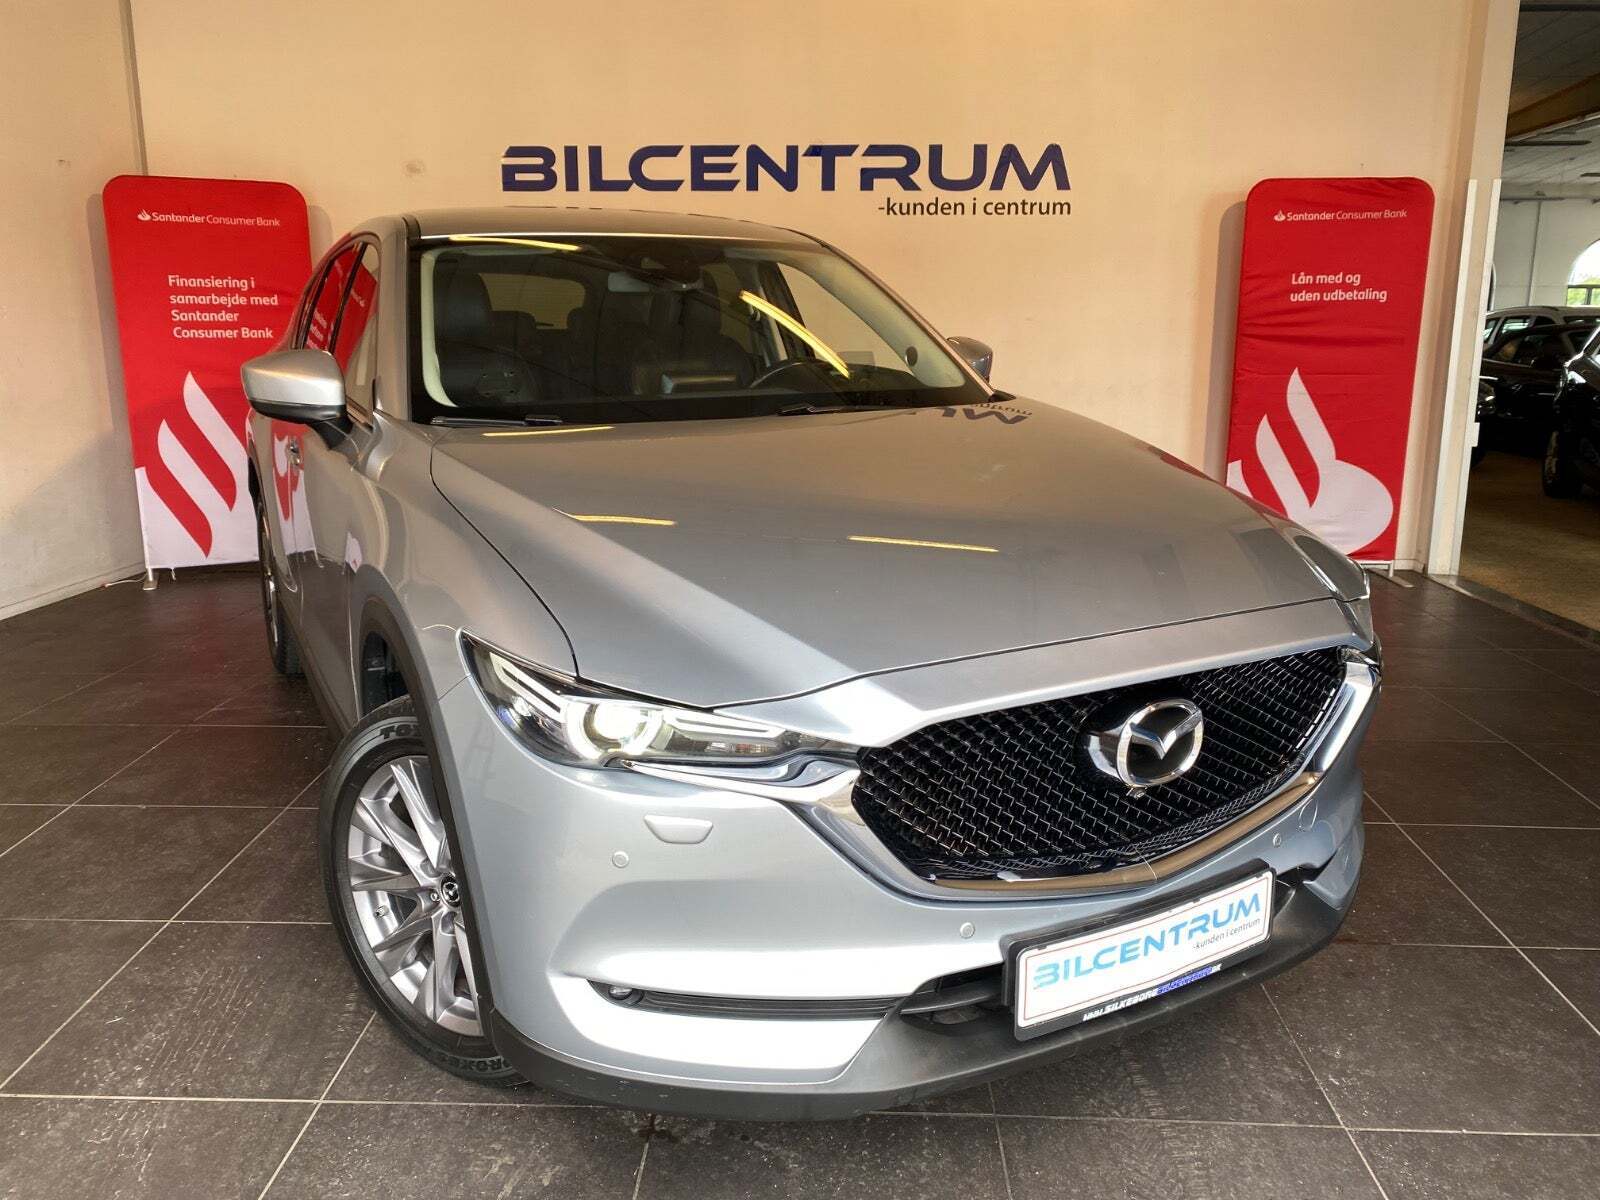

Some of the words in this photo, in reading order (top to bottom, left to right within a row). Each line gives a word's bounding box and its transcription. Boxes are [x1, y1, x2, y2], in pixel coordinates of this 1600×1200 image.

[502, 143, 1071, 192] BILCENTRUM
[878, 197, 966, 216] -kunden
[971, 198, 978, 215] i
[983, 199, 1071, 216] centrum
[152, 212, 205, 223] Santander
[207, 214, 255, 225] Consumer
[257, 217, 280, 227] Bank
[1287, 211, 1335, 222] Santander
[1336, 210, 1383, 220] Consumer
[1384, 209, 1407, 219] Bank
[168, 275, 248, 291] Finansiering
[250, 277, 256, 289] i
[1292, 271, 1313, 285] Lån
[1316, 273, 1343, 284] med
[1345, 274, 1361, 286] og
[169, 293, 247, 308] samarbejde
[249, 295, 279, 306] med
[1290, 289, 1320, 302] uden
[1323, 288, 1388, 303] udbetaling
[171, 310, 239, 322] Santander
[173, 326, 239, 339] Consumer
[241, 327, 273, 339] Bank
[1033, 892, 1261, 990] BILCENTRUM
